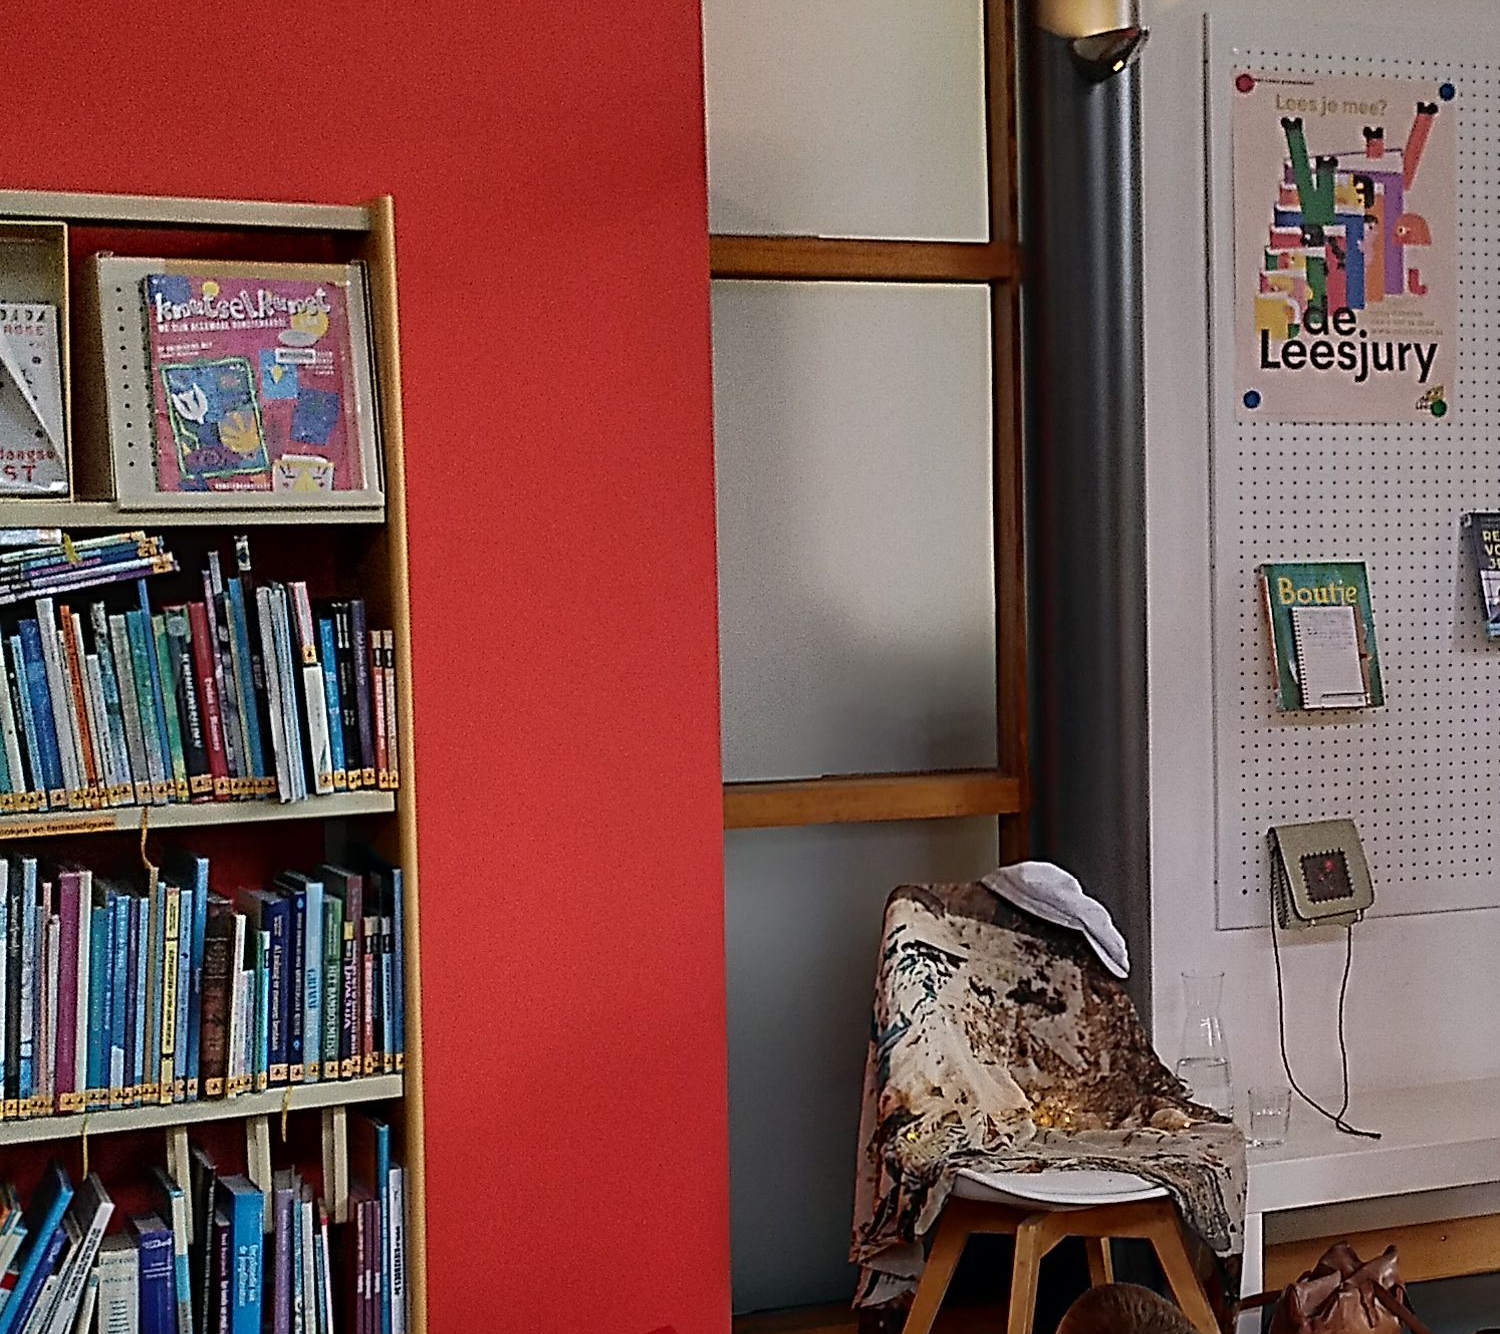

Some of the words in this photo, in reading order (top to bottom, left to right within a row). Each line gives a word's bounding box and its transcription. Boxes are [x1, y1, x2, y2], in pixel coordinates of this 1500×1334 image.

[1276, 94, 1317, 112] Lees
[1321, 96, 1338, 117] je
[1343, 99, 1388, 116] mee?
[1303, 294, 1357, 336] de
[1260, 329, 1438, 383] Leesjury
